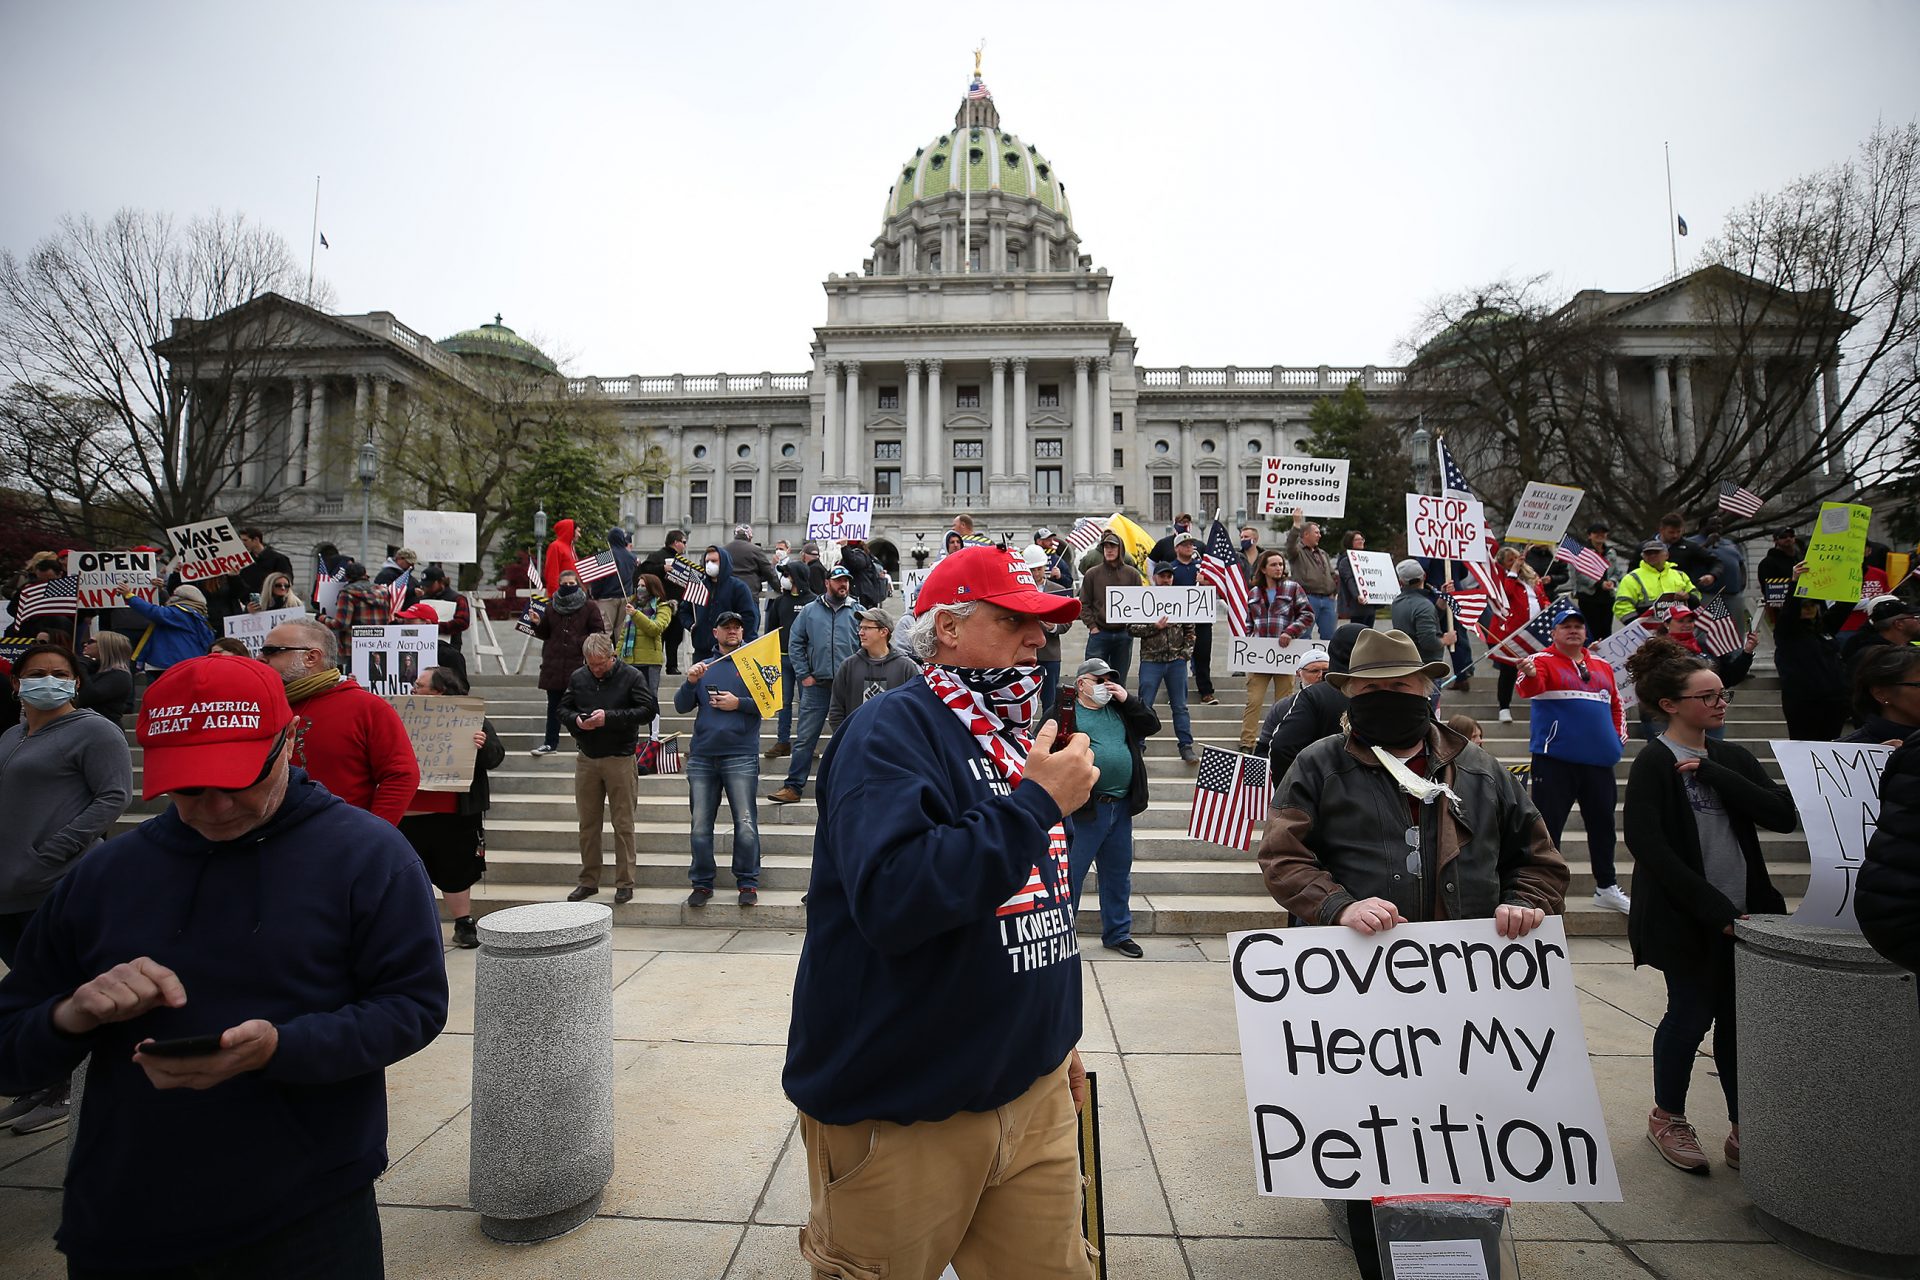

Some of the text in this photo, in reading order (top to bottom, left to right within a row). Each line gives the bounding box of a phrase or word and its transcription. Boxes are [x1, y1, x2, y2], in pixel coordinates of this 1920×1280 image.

[1267, 458, 1336, 475] Wrongfully
[1267, 473, 1340, 489] Oppressing
[811, 496, 869, 513] CHURCH
[1266, 487, 1340, 502] Livelihoods
[1532, 490, 1575, 503] RECALL OUR
[1265, 502, 1295, 514] Fear
[1419, 496, 1468, 522] STOP
[830, 511, 844, 526] IS
[173, 525, 234, 549] WAKE
[809, 523, 868, 540] ESSENTIAL
[1414, 518, 1476, 541] CRYING
[194, 546, 219, 560] UP
[1419, 537, 1470, 559] WOLF
[79, 553, 150, 572] OPEN
[182, 551, 253, 580] CHURCH
[1110, 588, 1214, 618] Re-Open PA!
[229, 621, 235, 635] I
[376, 640, 392, 649] ARE
[397, 641, 415, 650] NOT
[416, 641, 435, 651] OUR
[148, 701, 260, 720] MAKE AMERICA
[405, 699, 416, 710] A
[147, 715, 260, 736] GREAT AGAIN
[967, 758, 981, 781] I
[1810, 749, 1895, 800] AME
[1000, 920, 1008, 946] I
[1016, 907, 1069, 943] KNEEL
[1008, 940, 1048, 973] THE
[1233, 932, 1565, 1003] Governor
[1282, 1016, 1556, 1093] Hear My
[1254, 1104, 1598, 1193] Petition
